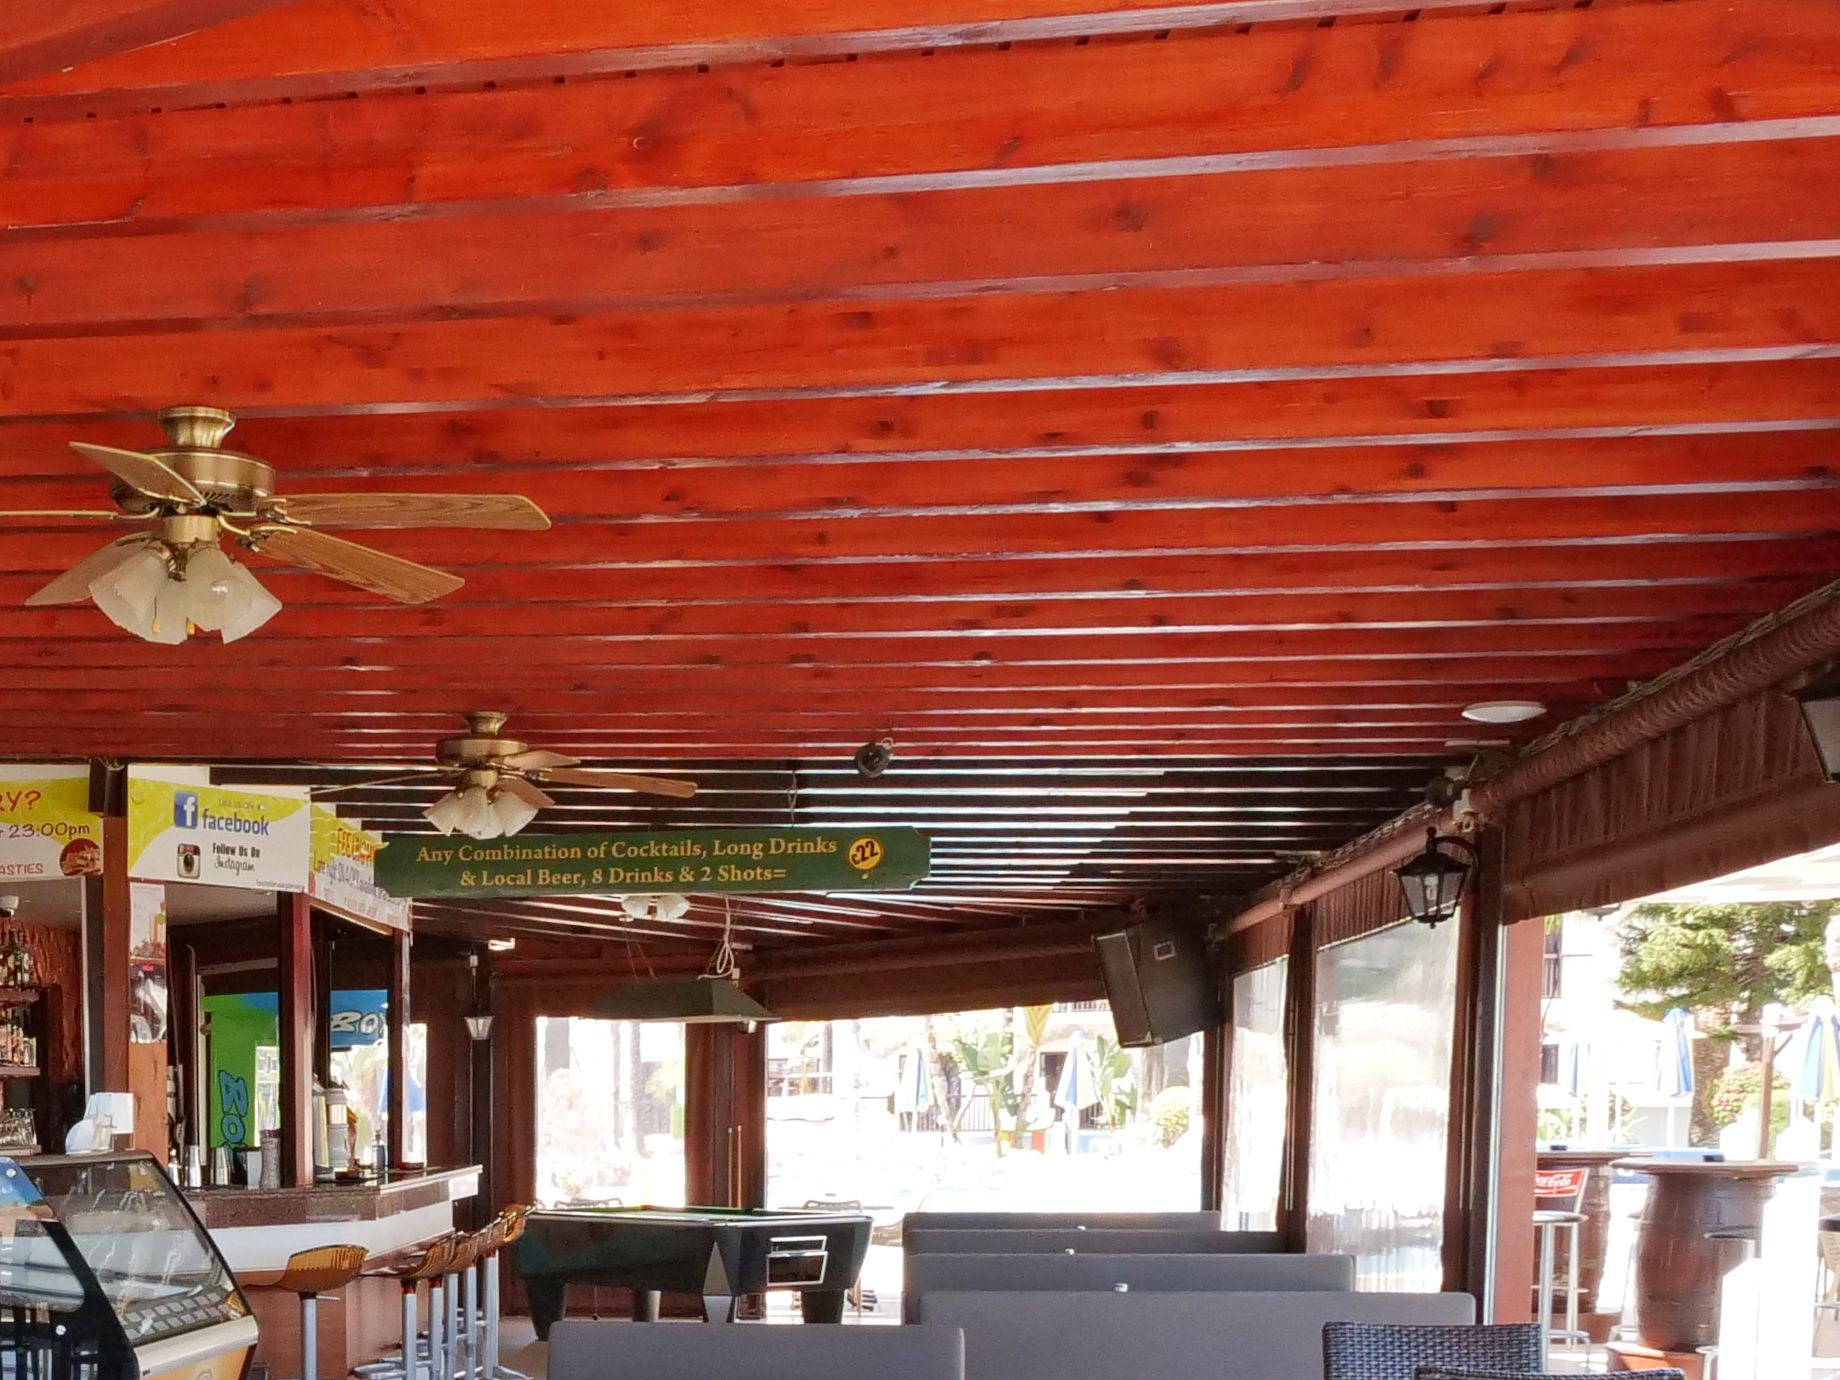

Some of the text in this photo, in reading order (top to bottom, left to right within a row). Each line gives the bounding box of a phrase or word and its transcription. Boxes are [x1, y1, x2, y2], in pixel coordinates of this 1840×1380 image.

[8, 822, 91, 839] 23:00pm
[202, 807, 270, 836] facebook
[212, 842, 260, 859] Follow Us On
[416, 836, 838, 866] Any Combination of Cocktails, Long Drinks
[213, 855, 255, 876] Instagram
[460, 870, 476, 886] &
[481, 869, 533, 886] Local
[537, 869, 587, 888] Beer,
[591, 868, 603, 884] 8
[608, 866, 674, 884] Drinks
[678, 866, 695, 882] &
[701, 866, 712, 882] 2
